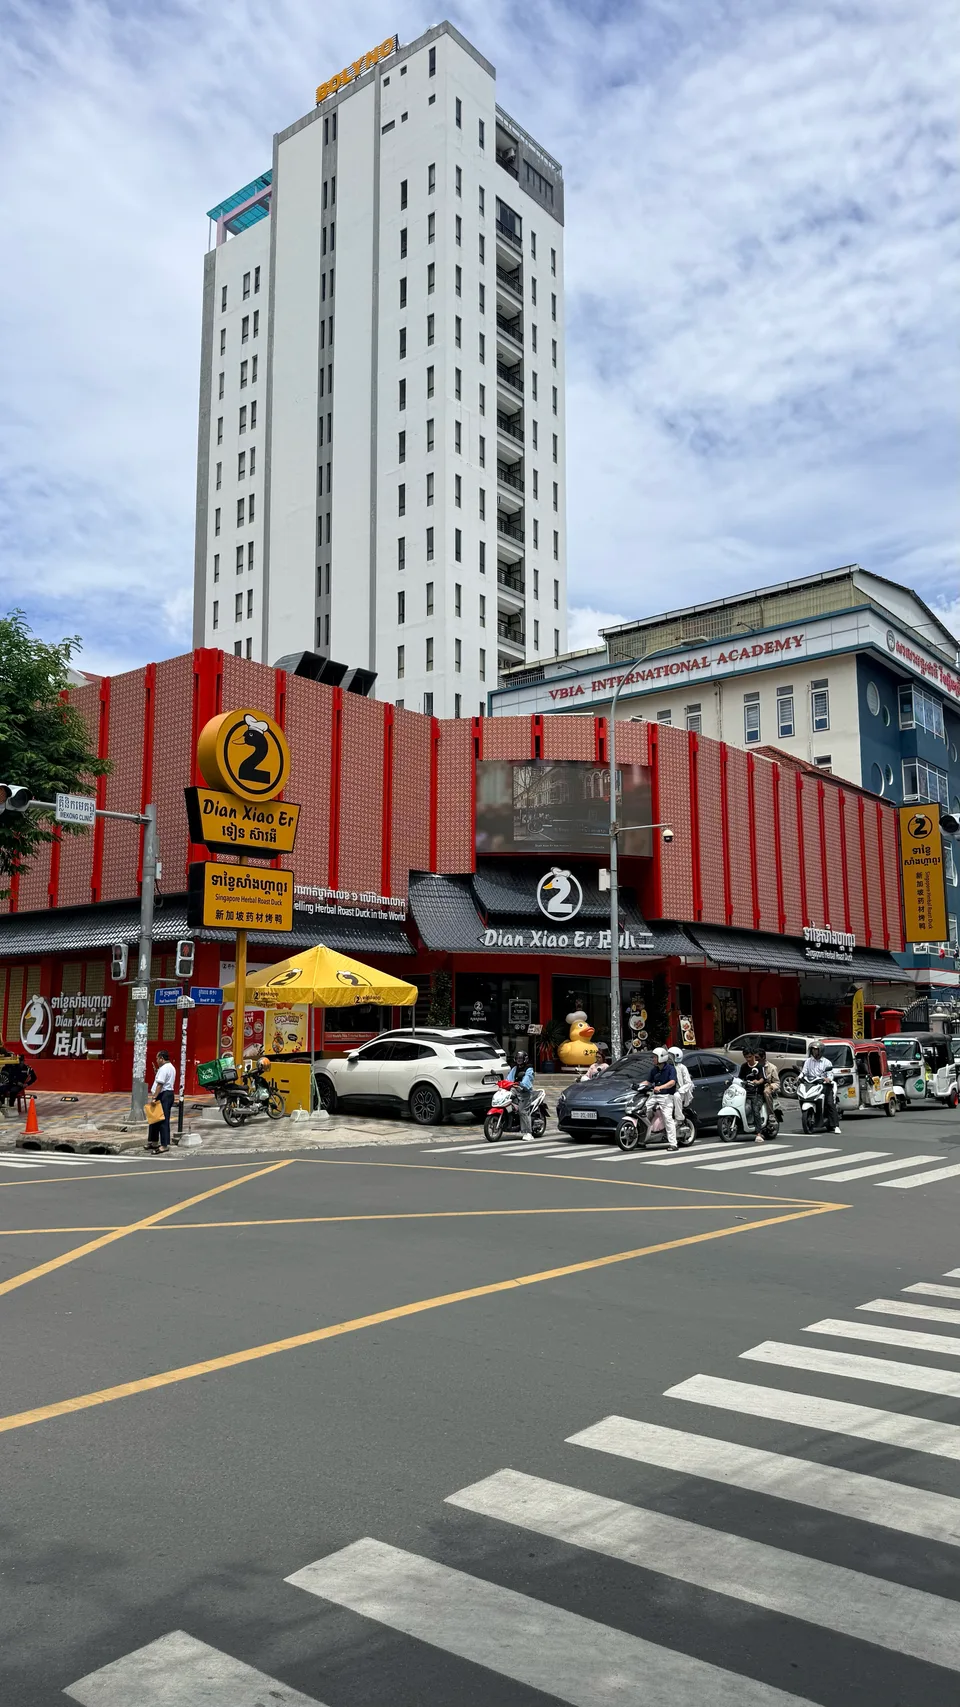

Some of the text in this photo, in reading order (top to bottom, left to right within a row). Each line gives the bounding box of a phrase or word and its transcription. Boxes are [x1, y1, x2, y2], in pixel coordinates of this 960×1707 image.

[317, 37, 393, 103] BOLYNO
[549, 634, 804, 700] VBIA INTERNATIONAL ACADEMY
[203, 799, 294, 827] Dian Xiao Er
[215, 893, 283, 906] Singapore Herbal Roast Duck
[294, 900, 406, 922] elling Herbal Roast Duck in the World
[915, 871, 926, 930] 新加坡药材烤鸭
[215, 909, 283, 925] 新加坡药材烤鸭
[484, 930, 593, 948] Dian Xiao Er
[55, 1013, 106, 1027] Dian Xiao Er
[53, 1031, 102, 1057] 店小二
